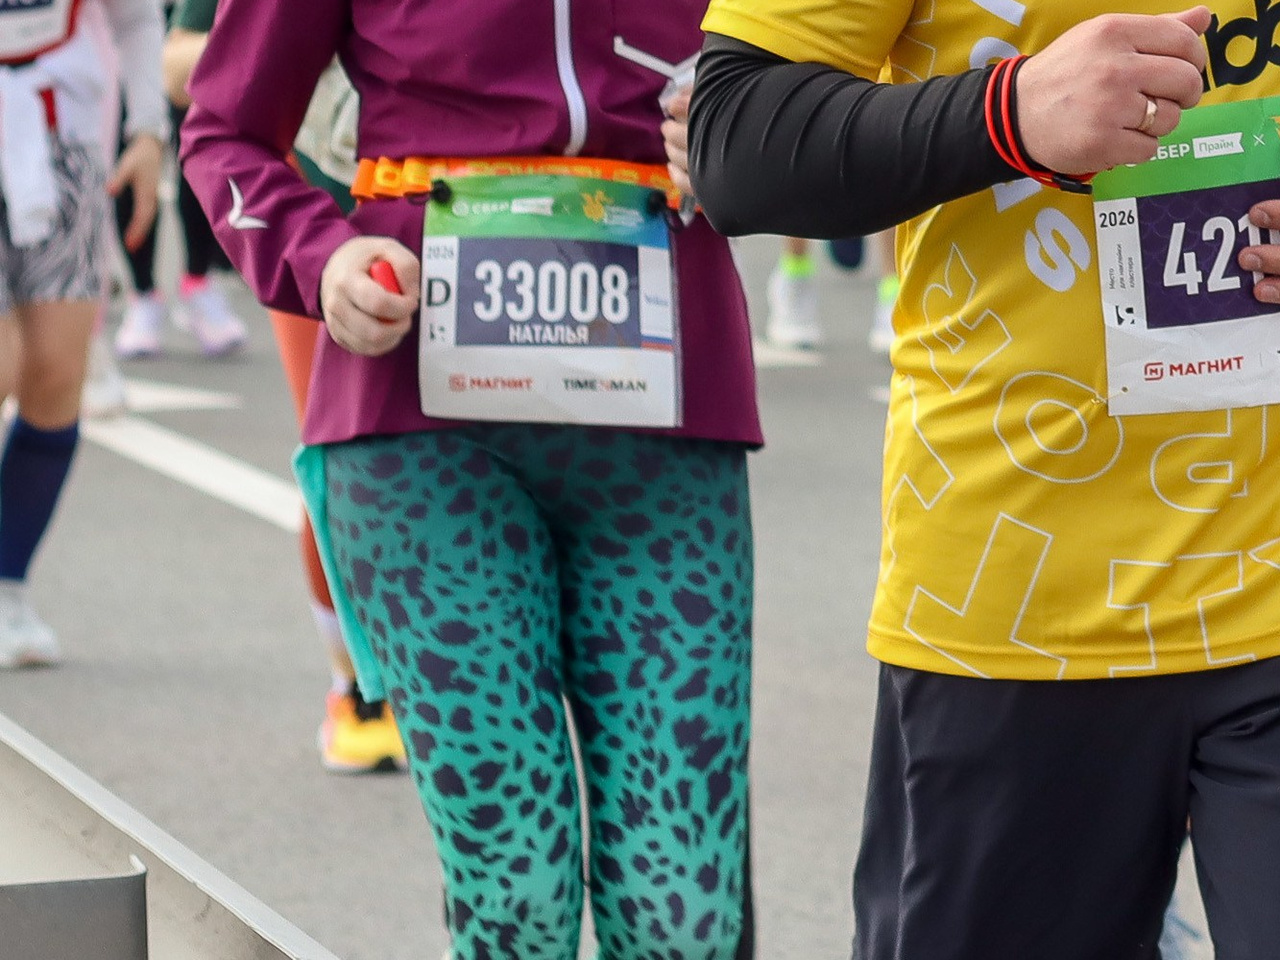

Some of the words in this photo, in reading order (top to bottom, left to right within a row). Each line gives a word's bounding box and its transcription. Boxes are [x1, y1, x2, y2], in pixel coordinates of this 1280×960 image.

[1150, 143, 1190, 160] БЕР
[1199, 140, 1235, 153] Прайм
[1099, 210, 1135, 228] 2026
[426, 278, 451, 307] D
[473, 260, 630, 324] 33008
[509, 324, 589, 345] НАТАЛЬЯ
[1169, 356, 1245, 377] МАГНИТ
